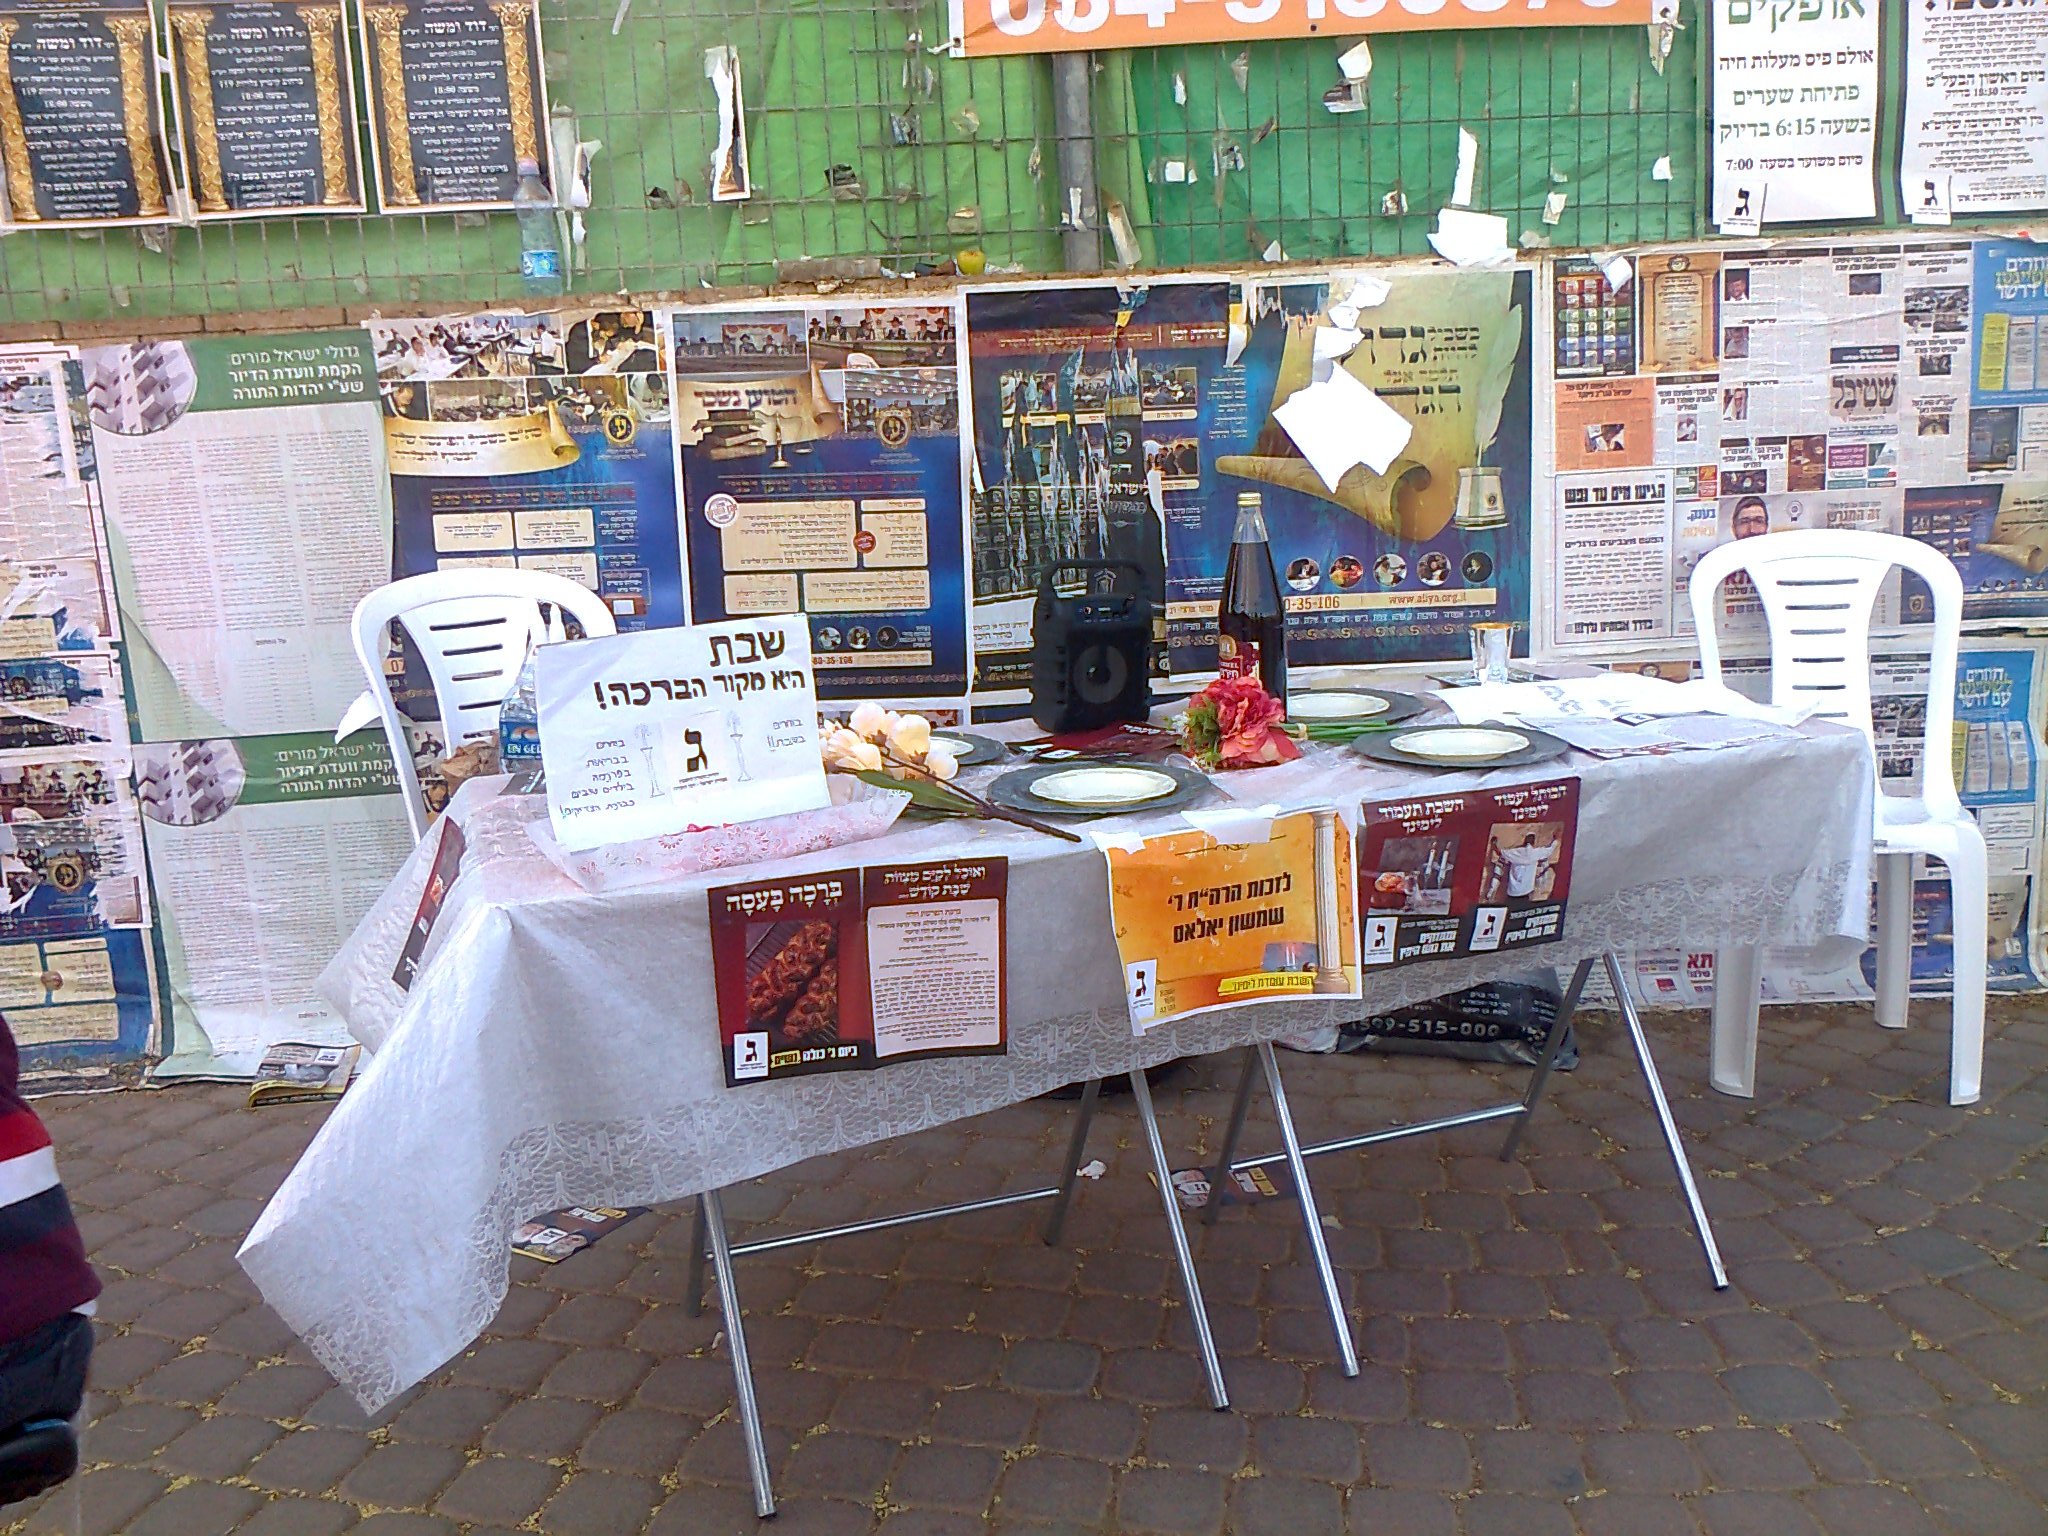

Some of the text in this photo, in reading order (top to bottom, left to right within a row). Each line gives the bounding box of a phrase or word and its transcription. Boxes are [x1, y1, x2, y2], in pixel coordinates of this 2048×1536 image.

[230, 26, 295, 40] דוד ומשה
[424, 20, 487, 34] דוד ומשה
[36, 37, 103, 50] דוד ומשה
[1719, 46, 1874, 70] אולם פיס מעלות חיה
[1979, 71, 2017, 87] ראשון
[2020, 70, 2045, 82] ביום
[1733, 85, 1860, 106] פתיחת שערים
[1719, 117, 1871, 144] בשעה 6:15 בדיוק
[1725, 155, 1863, 171] סיום משוער בשעה 7:00
[1734, 188, 1750, 217] ג
[1924, 180, 1938, 206] ג
[273, 347, 320, 362] ישראל
[324, 345, 360, 359] גדולי
[229, 363, 362, 383] הקמת וועדת הדיור
[232, 386, 279, 400] התורה
[282, 382, 324, 397] יהדות
[709, 630, 785, 667] שבת
[594, 670, 806, 710] היא מקור הברכה!
[319, 745, 364, 760] ישראל
[684, 727, 708, 773] ג
[276, 759, 393, 779] קמת וועדת הדיור
[280, 780, 324, 793] התורה
[327, 776, 367, 790] יהדות
[1378, 799, 1465, 821] השבת תעמוד
[1402, 814, 1443, 834] לימינך
[1167, 872, 1292, 912] לזכות הרה"ח ר'
[1173, 906, 1285, 943] שמשון יאלאס
[1482, 913, 1496, 936] ג
[1374, 923, 1386, 948] ג
[1135, 969, 1147, 998] ג
[745, 1040, 758, 1063] ג
[838, 1045, 858, 1058] ביום
